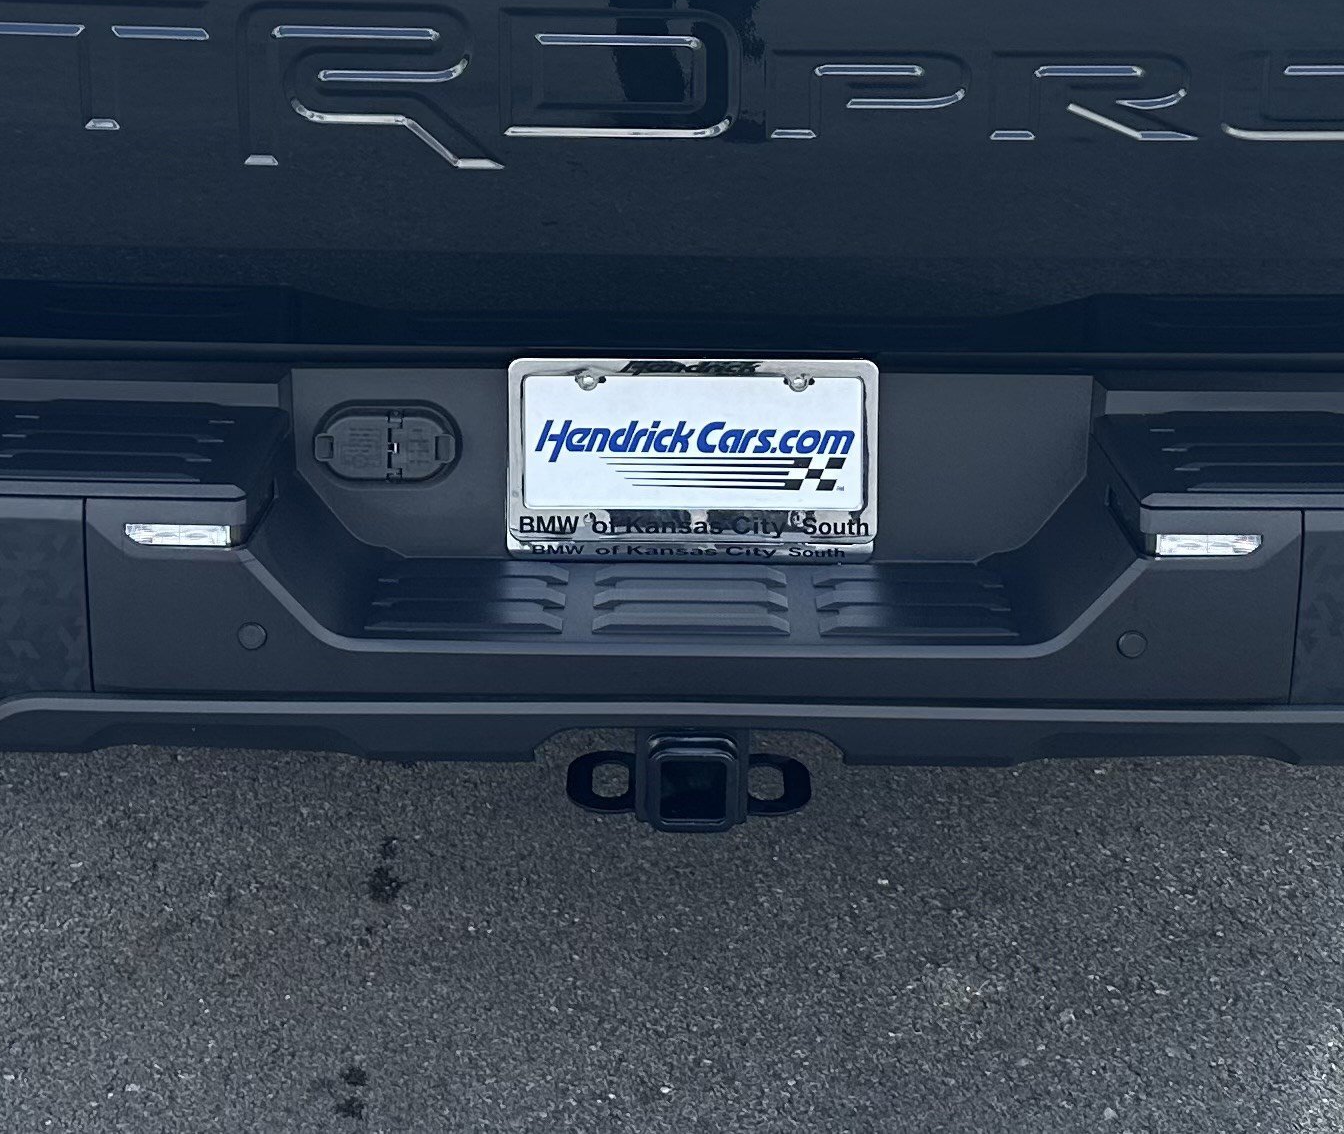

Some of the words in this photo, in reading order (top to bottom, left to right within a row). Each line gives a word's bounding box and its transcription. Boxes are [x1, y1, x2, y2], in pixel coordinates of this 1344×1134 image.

[519, 515, 579, 535] BMW
[591, 516, 615, 534] of
[625, 515, 722, 535] Kansas
[733, 516, 788, 538] City
[802, 517, 870, 536] South
